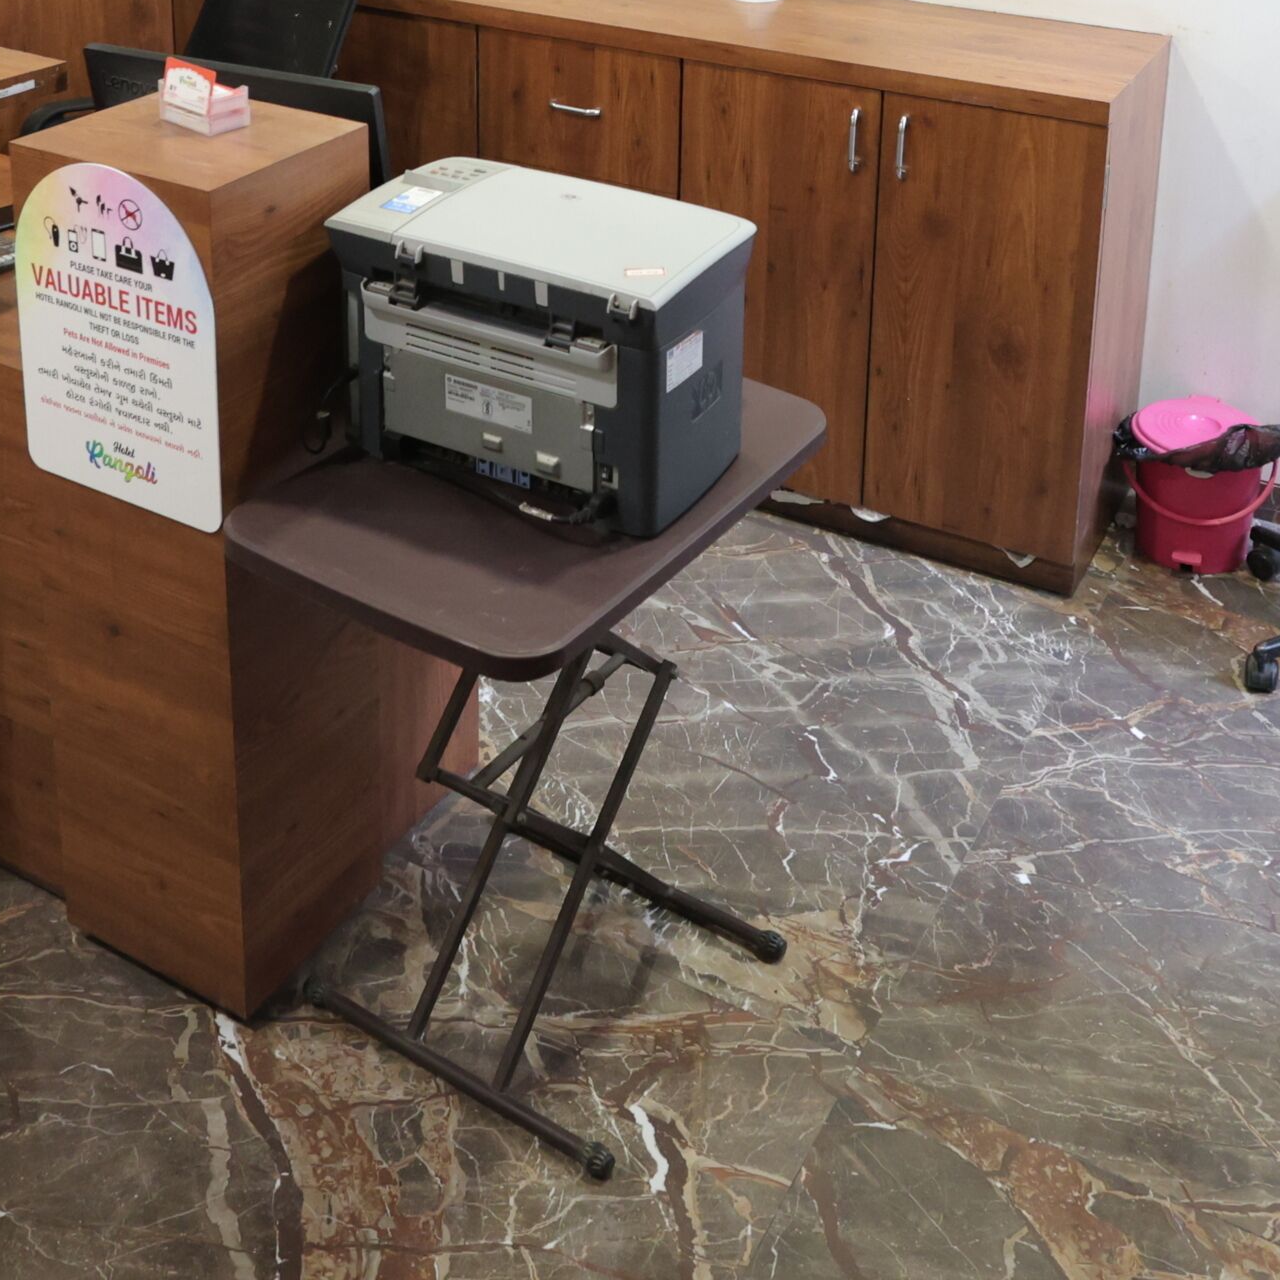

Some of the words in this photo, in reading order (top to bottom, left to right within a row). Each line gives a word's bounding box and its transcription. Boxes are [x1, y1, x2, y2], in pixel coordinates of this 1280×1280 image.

[70, 260, 94, 274] PLEASE
[97, 269, 113, 280] TAKE
[115, 274, 132, 286] CARE
[135, 280, 152, 292] YOUR
[32, 263, 130, 314] VALUABLE
[137, 295, 197, 335] ITEMS
[35, 291, 55, 304] HOTEL
[56, 298, 82, 313] RANGOLI
[84, 307, 98, 318] WILL
[100, 312, 112, 322] NOT
[114, 316, 121, 325] BE
[123, 319, 166, 339] RESPONSIBLE
[168, 334, 181, 344] FOR
[183, 338, 195, 349] THE
[64, 328, 78, 339] Pets
[80, 334, 90, 343] Are
[92, 337, 103, 347] Not
[105, 342, 129, 356] Allowed
[140, 353, 170, 370] Premises
[90, 322, 110, 335] THEFT
[112, 329, 120, 338] OR
[122, 333, 139, 345] LOSS
[84, 439, 158, 485] Rangoli
[114, 441, 135, 459] Hotel
